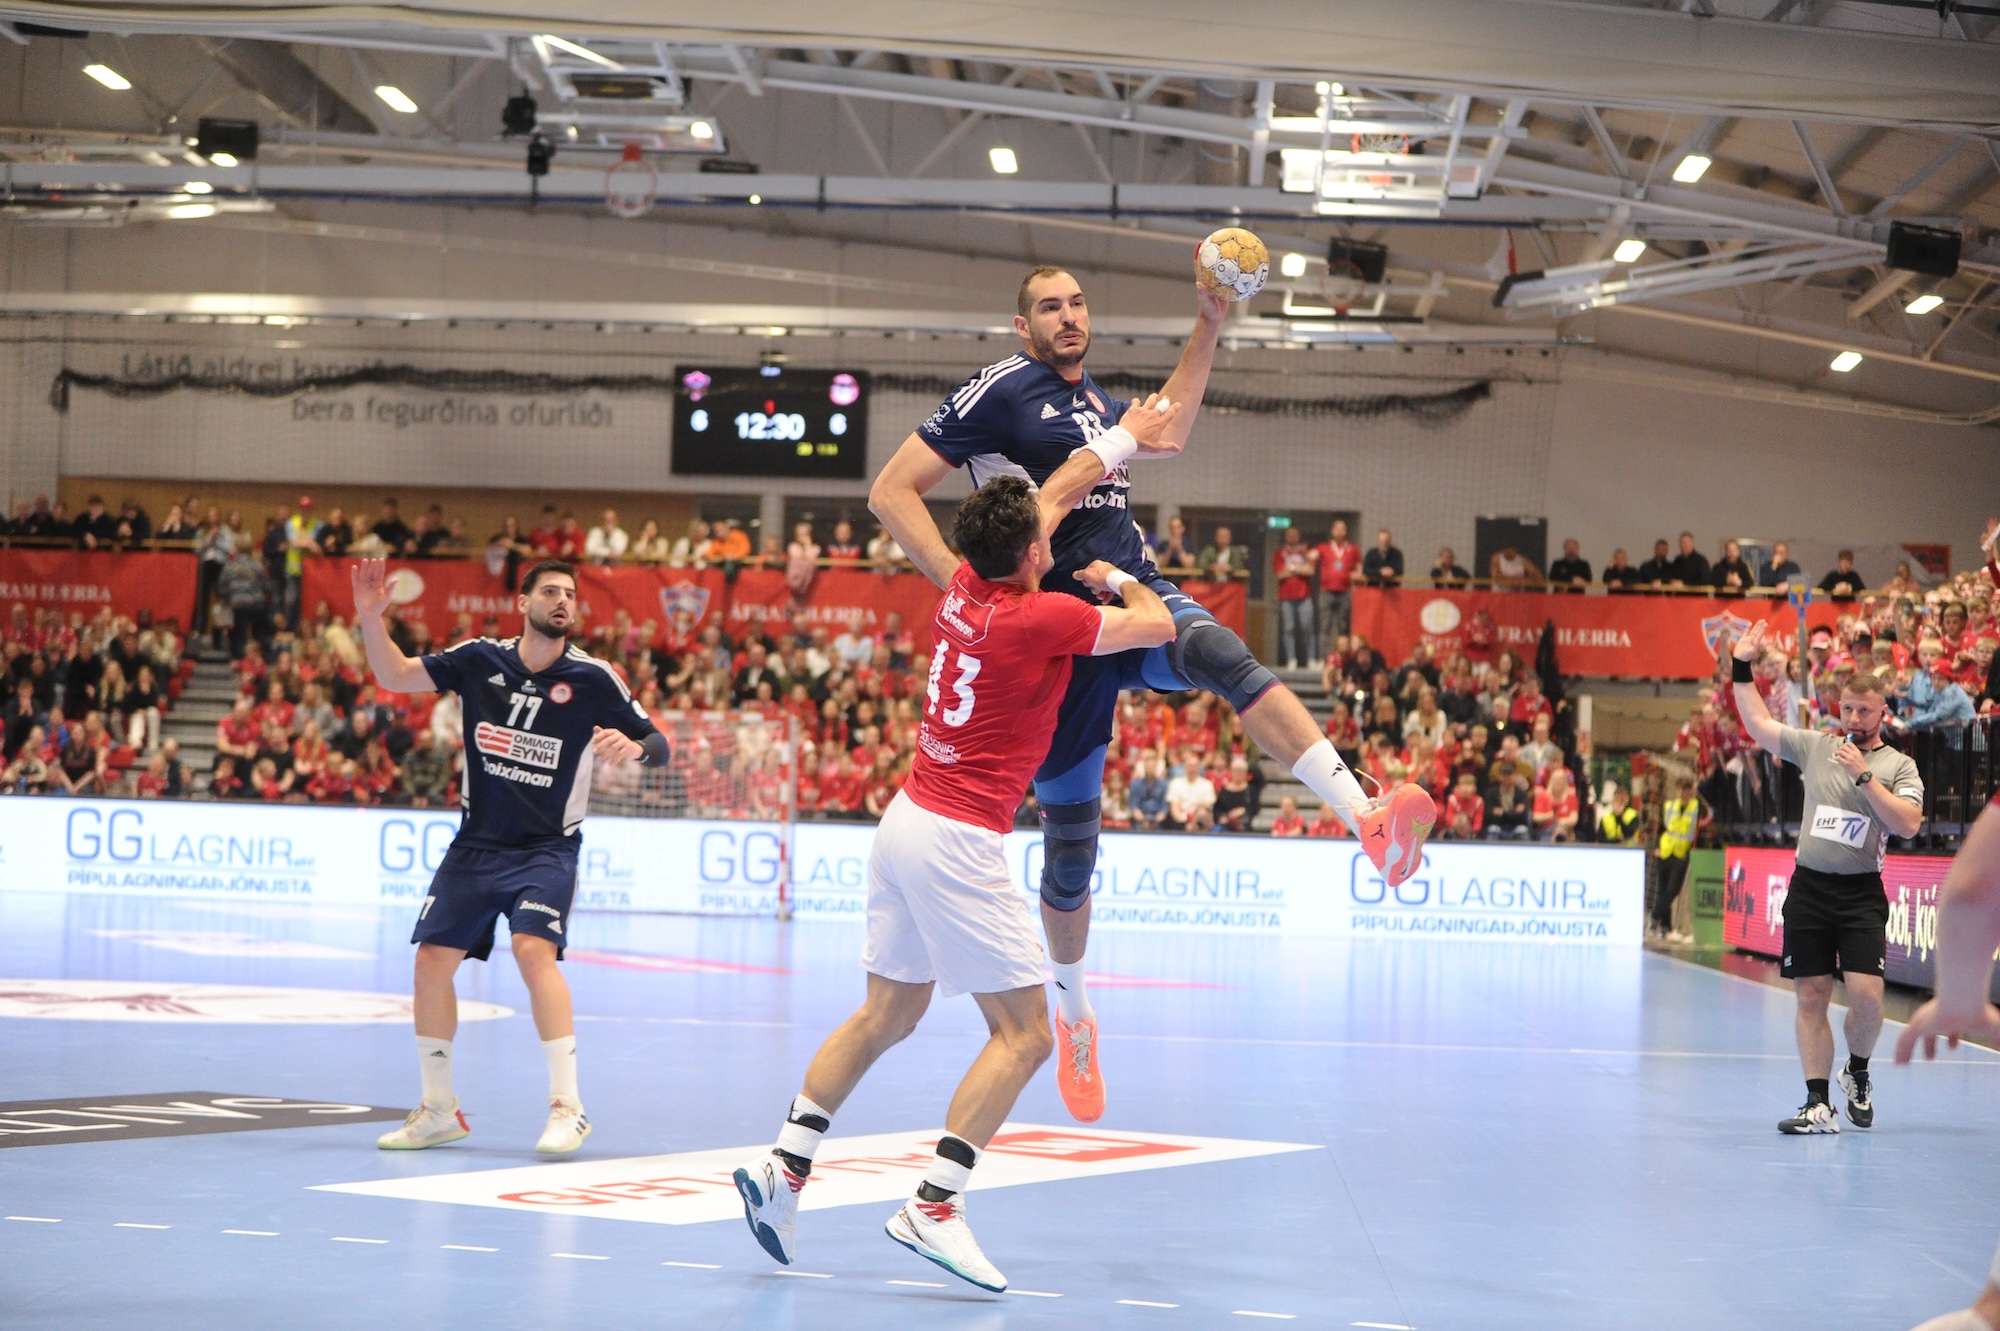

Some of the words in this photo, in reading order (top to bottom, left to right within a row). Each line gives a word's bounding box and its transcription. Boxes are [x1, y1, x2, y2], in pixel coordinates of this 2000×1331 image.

[366, 397, 498, 428] fegurðina
[690, 409, 709, 432] 6
[734, 412, 806, 440] 12:30
[829, 413, 847, 435] 6
[0, 582, 36, 599] RAM
[448, 592, 514, 613] ÁFRAM
[1497, 625, 1544, 645] FRA
[1558, 628, 1631, 647] HÆRRA
[927, 638, 981, 727] 13
[506, 692, 543, 730] 77
[513, 734, 557, 751] ΟΜΙΛΟΣ
[510, 745, 555, 765] ΞΥΝΗ
[1816, 817, 1839, 827] EHF
[1841, 816, 1866, 841] TV
[519, 900, 561, 918] Stoiximan
[1352, 914, 1608, 937] PÍPULAGNINGAÞJÓNUSTA
[0, 1097, 373, 1138] SALT
[497, 1176, 736, 1206] LEIÐ
